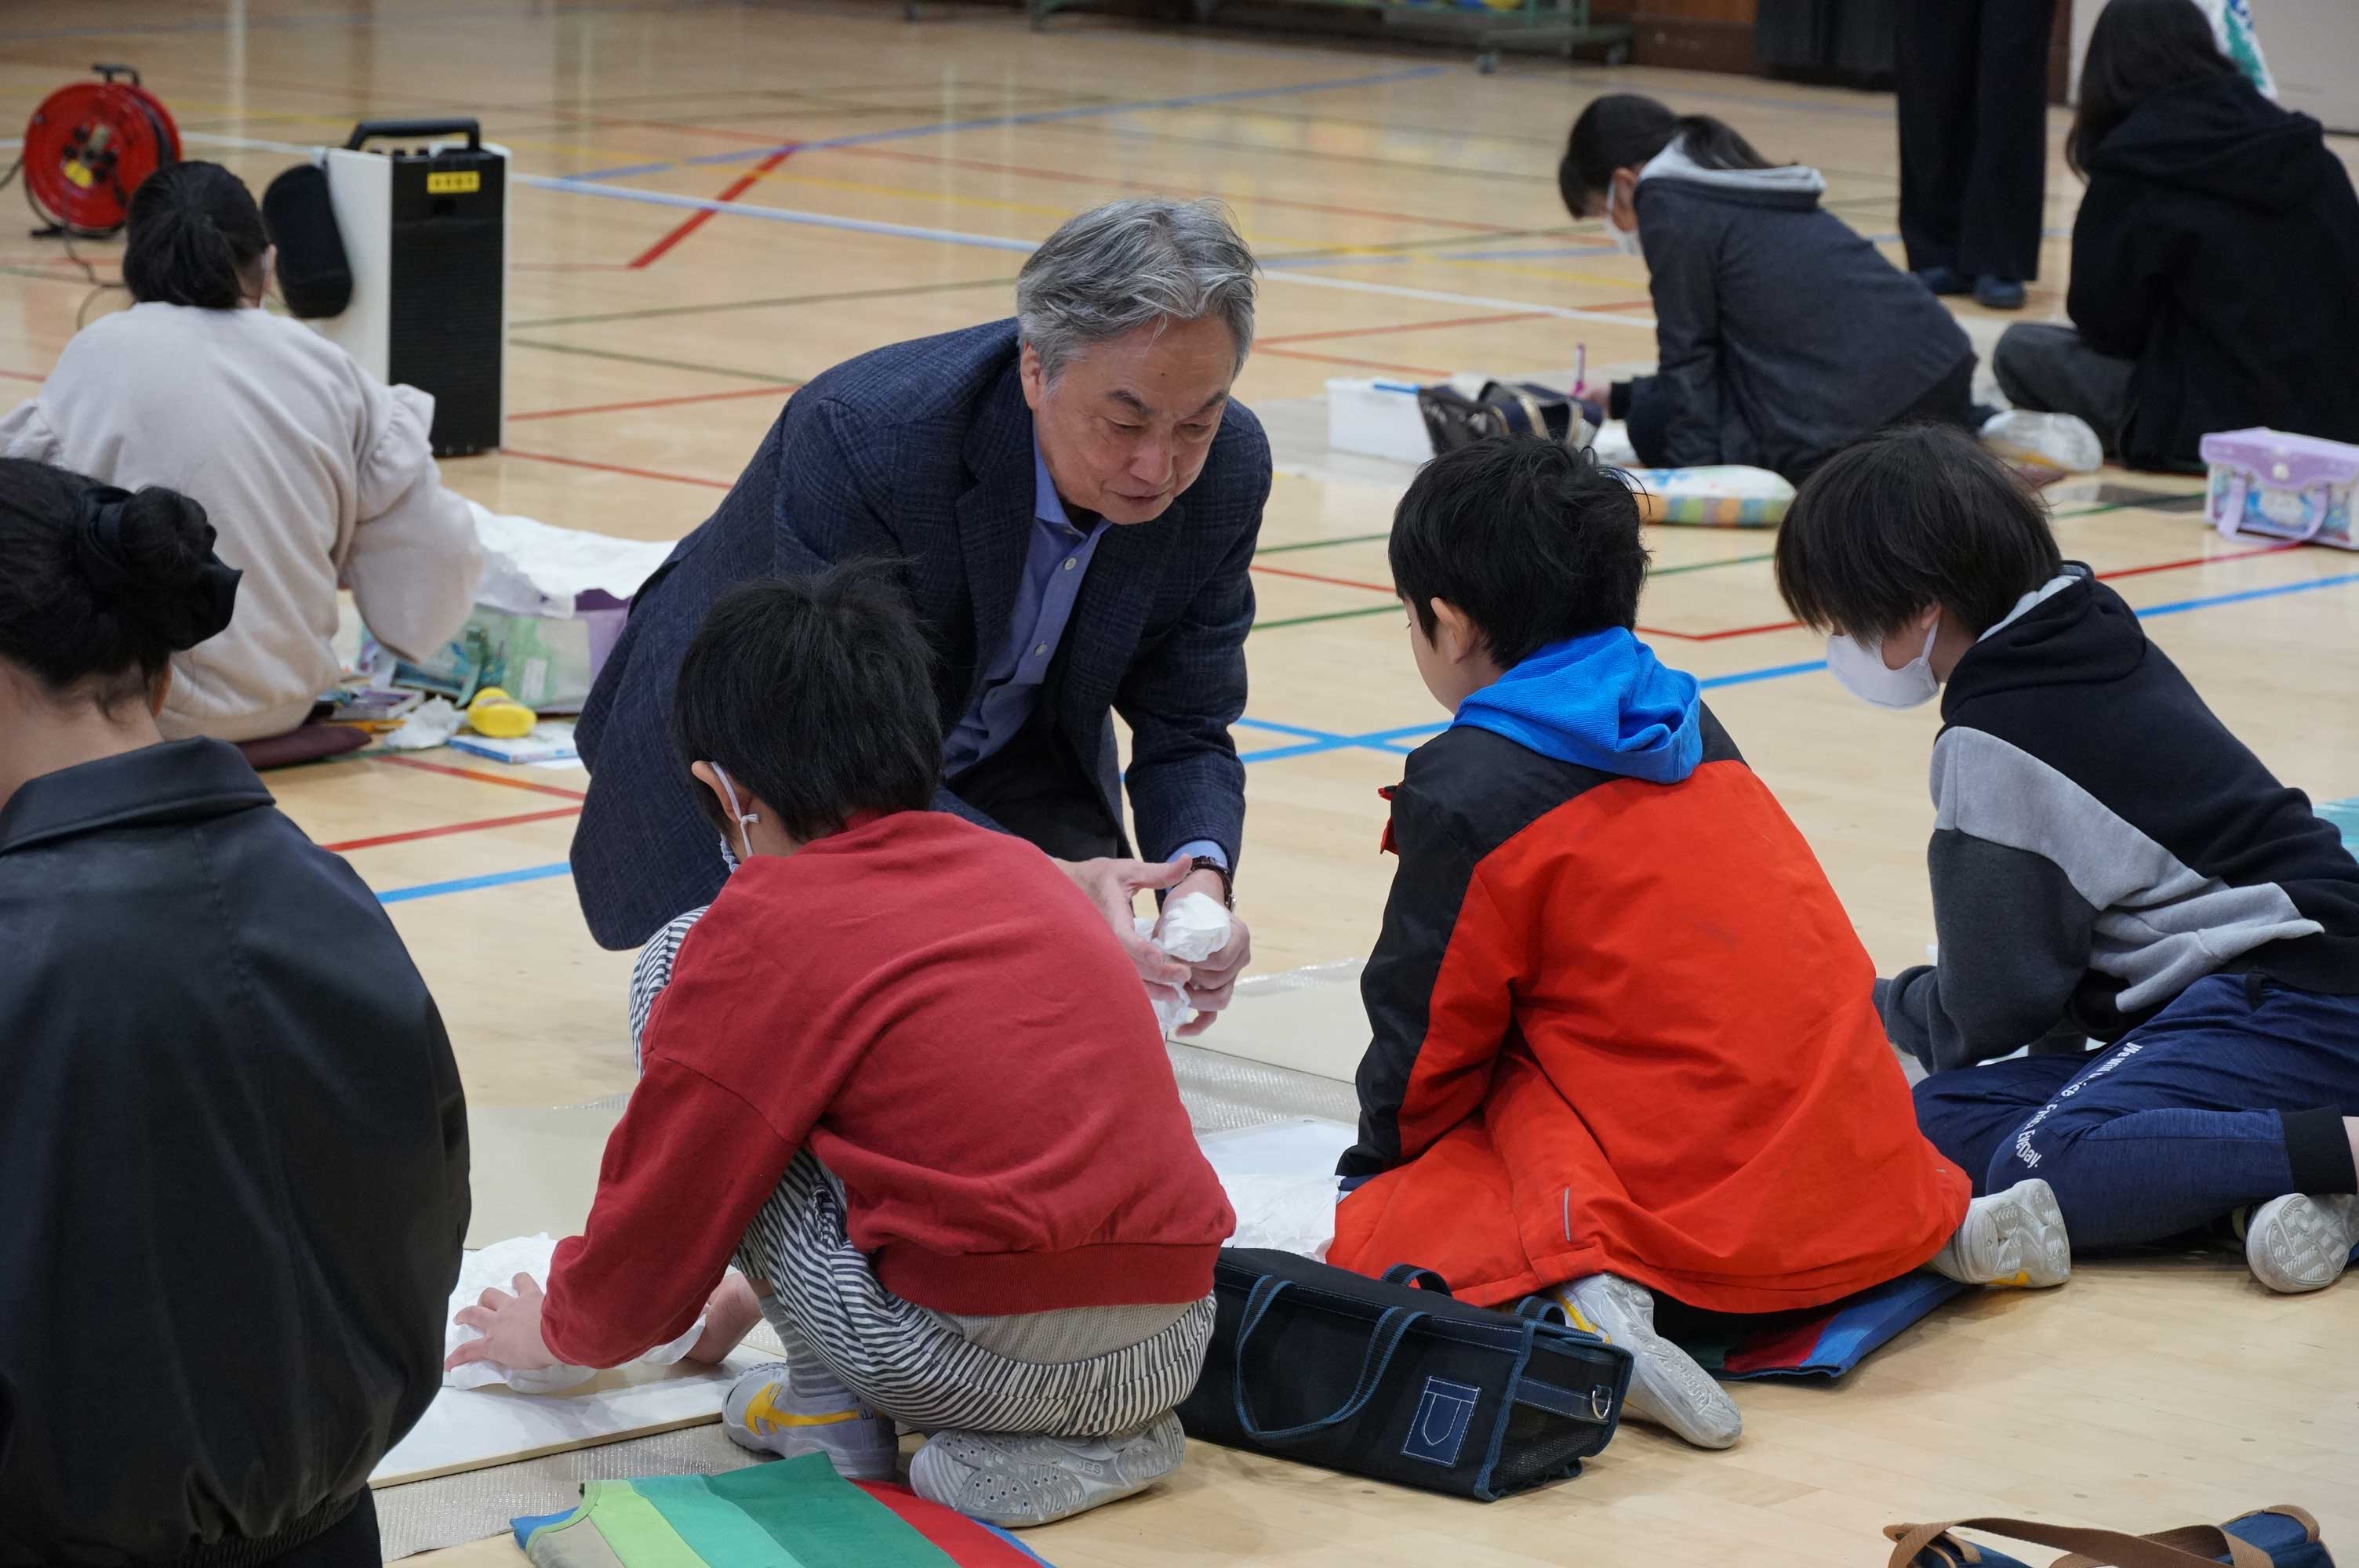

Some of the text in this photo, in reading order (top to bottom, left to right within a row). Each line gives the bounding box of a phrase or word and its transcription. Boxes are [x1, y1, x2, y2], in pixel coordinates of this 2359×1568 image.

[2117, 1042, 2144, 1058] We
[2096, 1058, 2126, 1072] Will
[1077, 1461, 1102, 1475] JES
